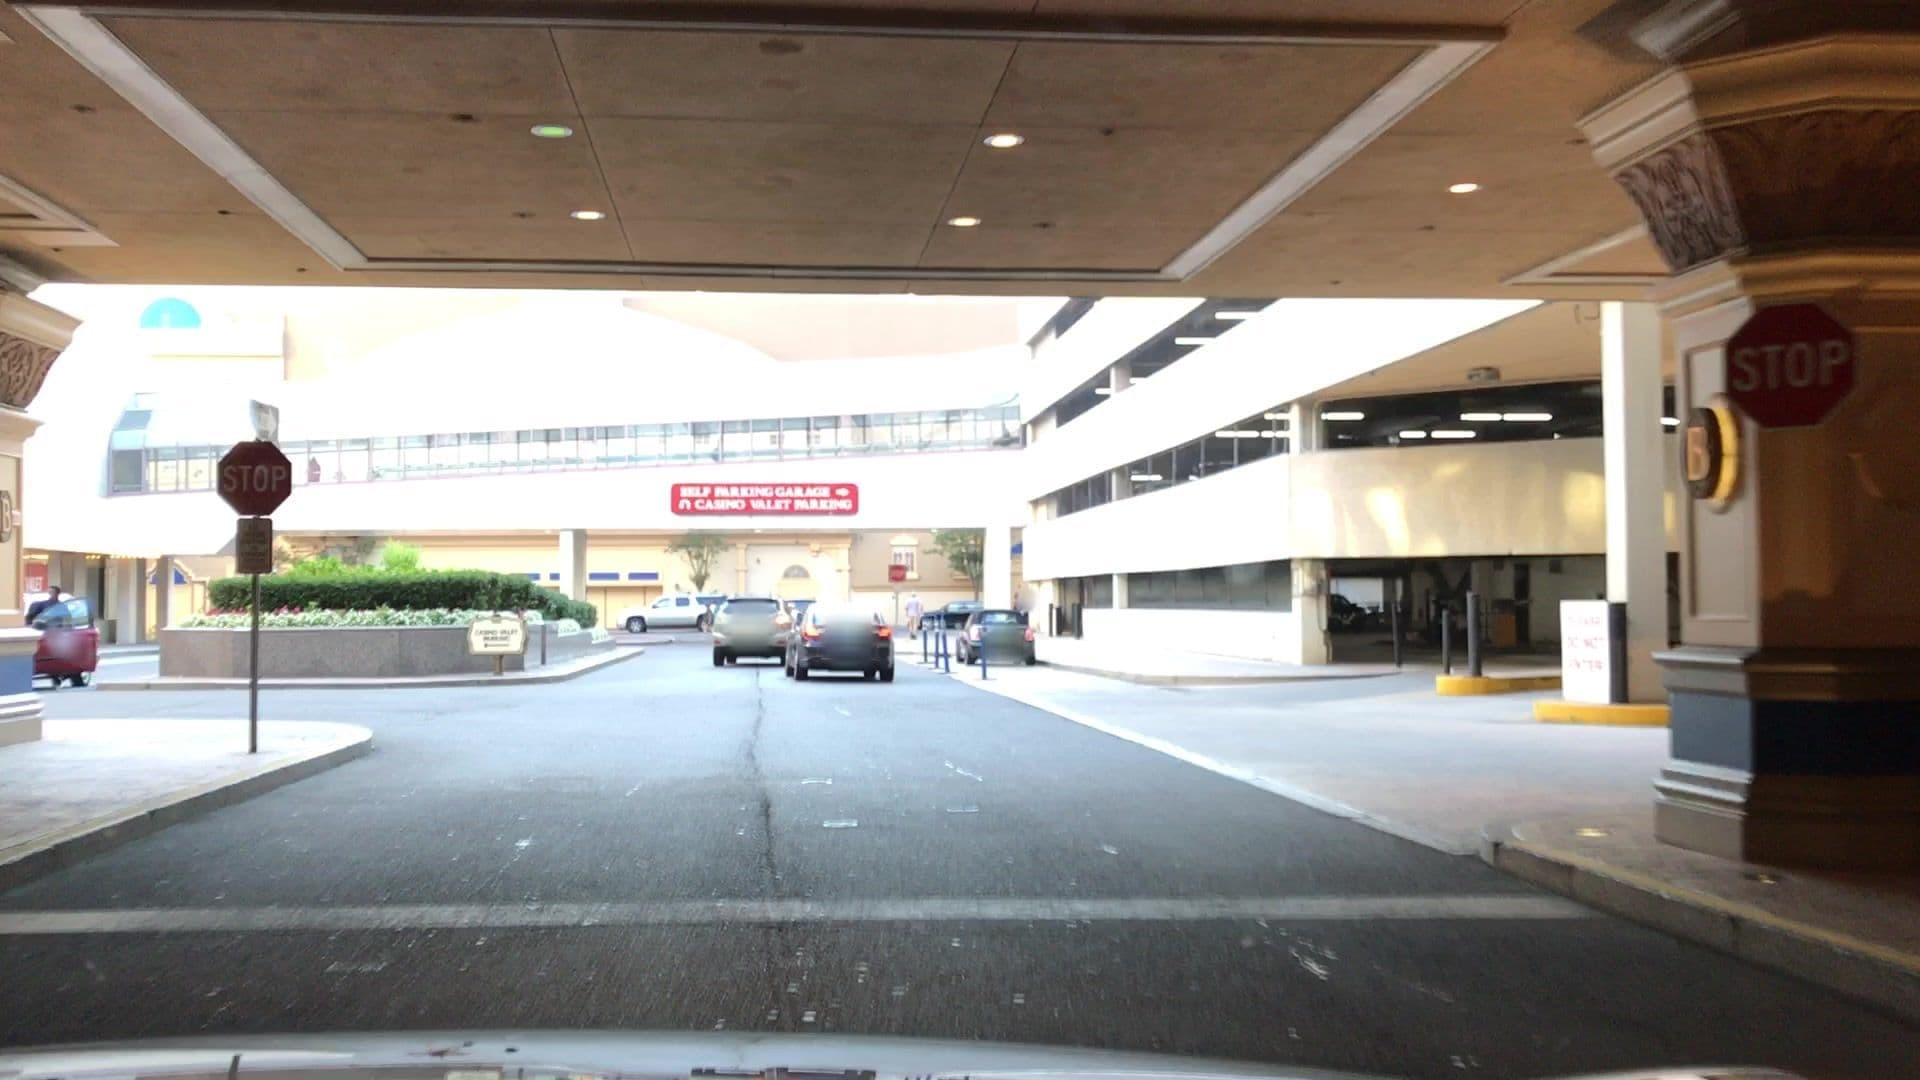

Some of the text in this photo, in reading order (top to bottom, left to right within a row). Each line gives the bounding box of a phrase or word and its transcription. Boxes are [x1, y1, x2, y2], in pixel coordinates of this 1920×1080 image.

[1733, 340, 1849, 391] STOP
[224, 465, 286, 493] STOP
[680, 486, 831, 497] SELF PARKING GARAGE
[694, 498, 853, 510] CASINO VALET PARKING
